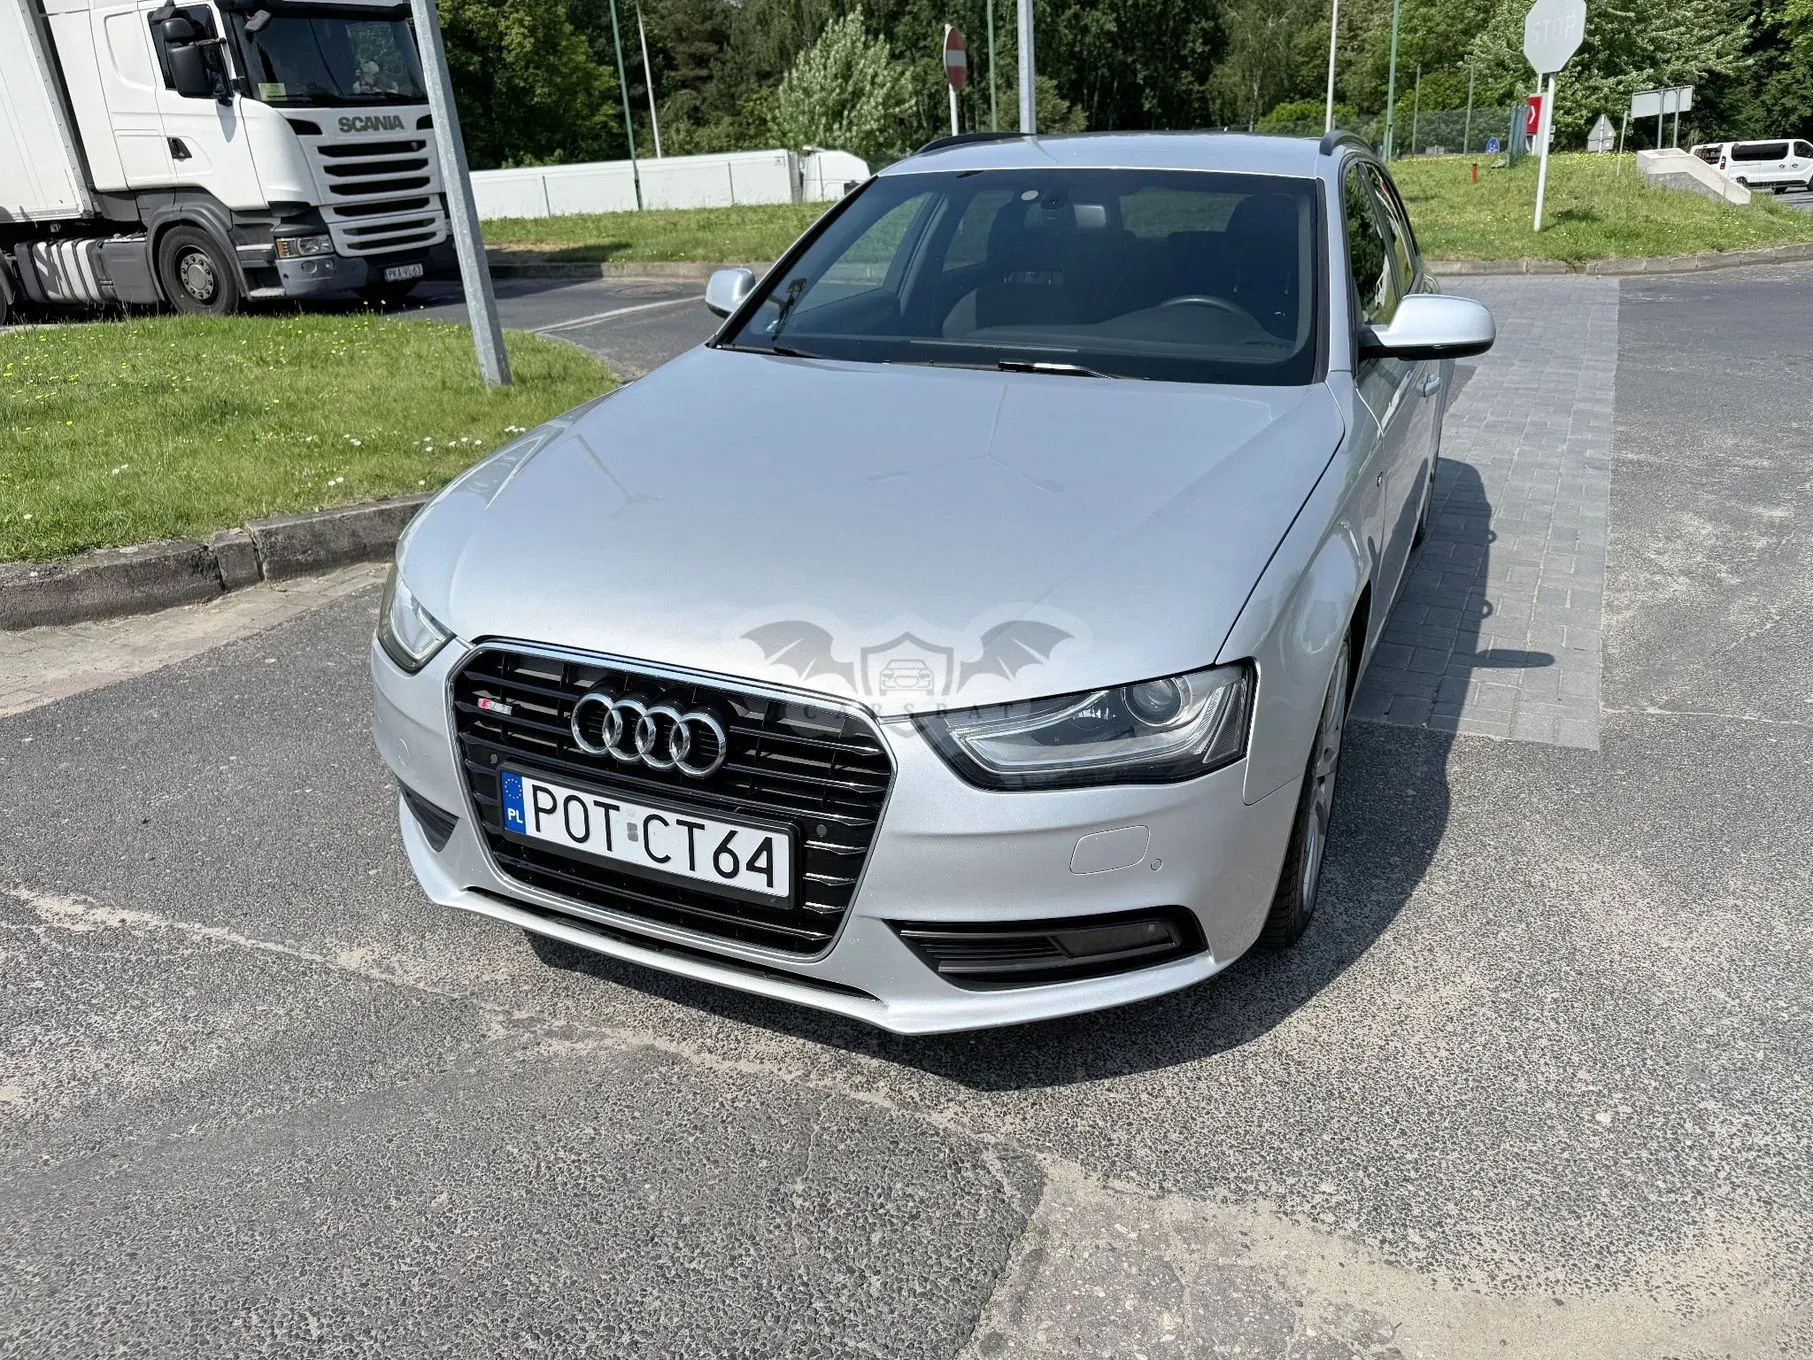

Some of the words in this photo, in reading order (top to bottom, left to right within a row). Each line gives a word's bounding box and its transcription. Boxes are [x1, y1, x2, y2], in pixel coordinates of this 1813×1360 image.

[1531, 14, 1577, 44] STOP
[338, 115, 404, 133] SCANIA
[507, 807, 524, 824] PL
[531, 784, 620, 852] POT
[642, 813, 775, 889] CT64
